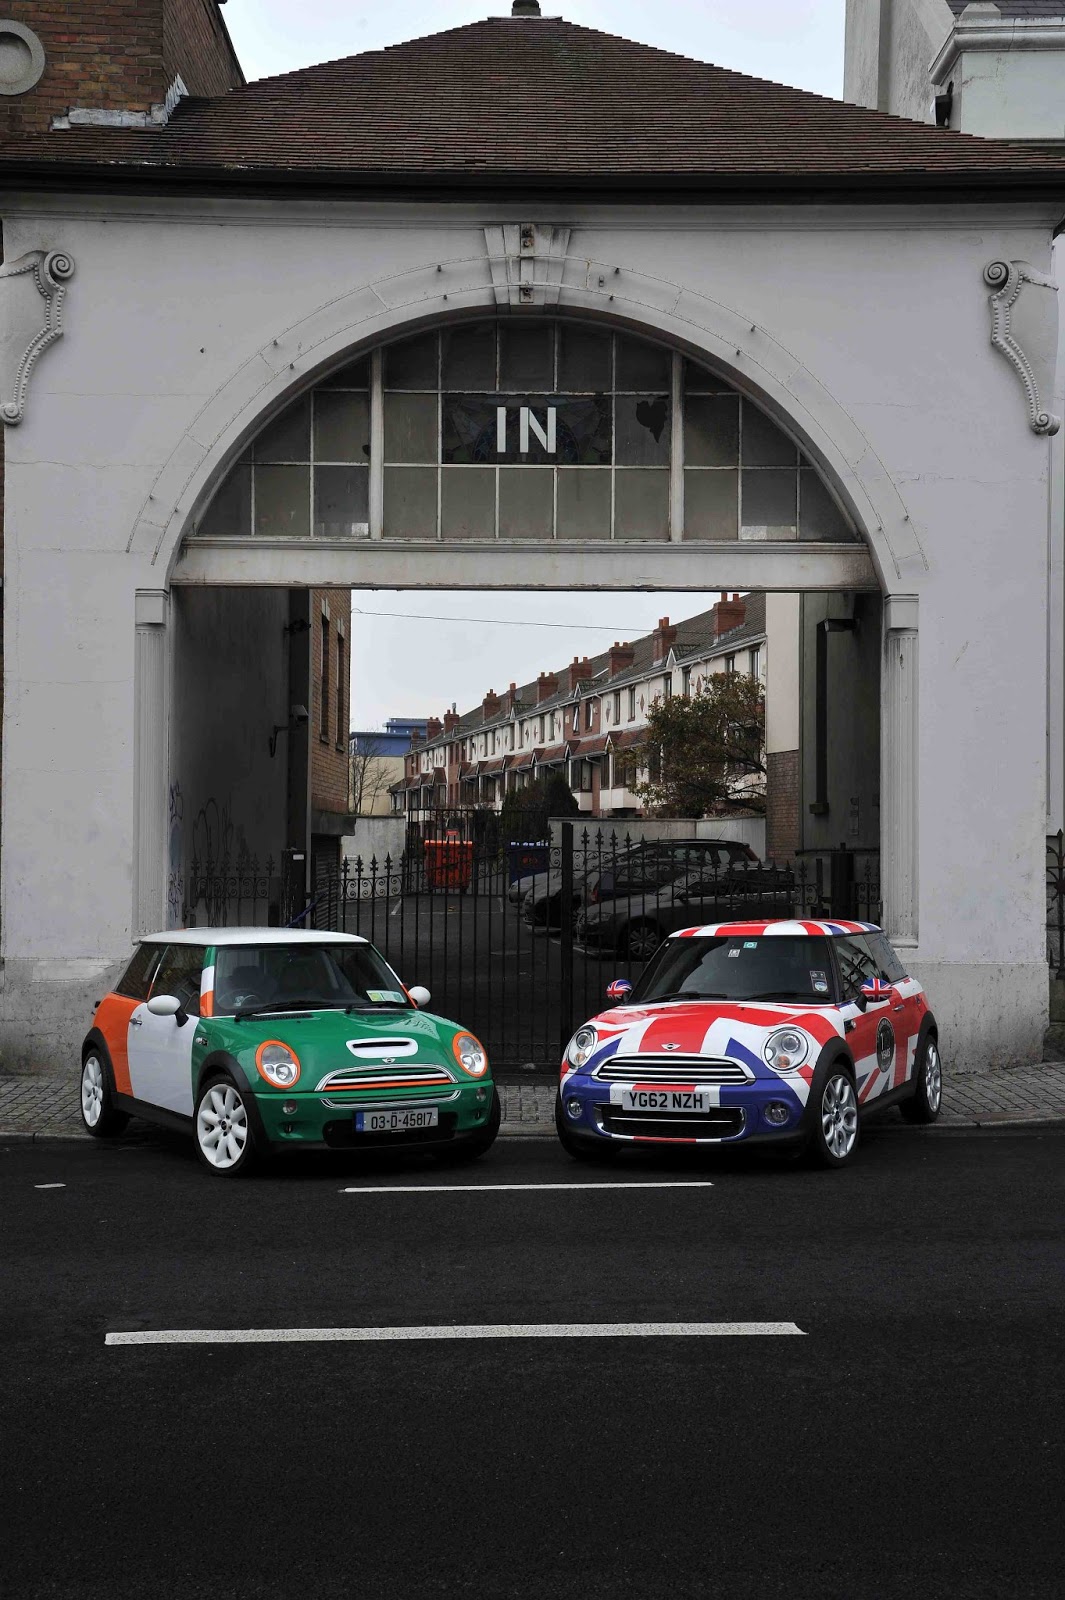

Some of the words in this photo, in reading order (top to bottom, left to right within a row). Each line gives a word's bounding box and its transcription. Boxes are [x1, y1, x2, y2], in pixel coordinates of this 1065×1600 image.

[496, 407, 557, 454] IN
[629, 1092, 668, 1108] YG62
[672, 1093, 703, 1109] NZH
[371, 1112, 433, 1129] 03-D-45817
